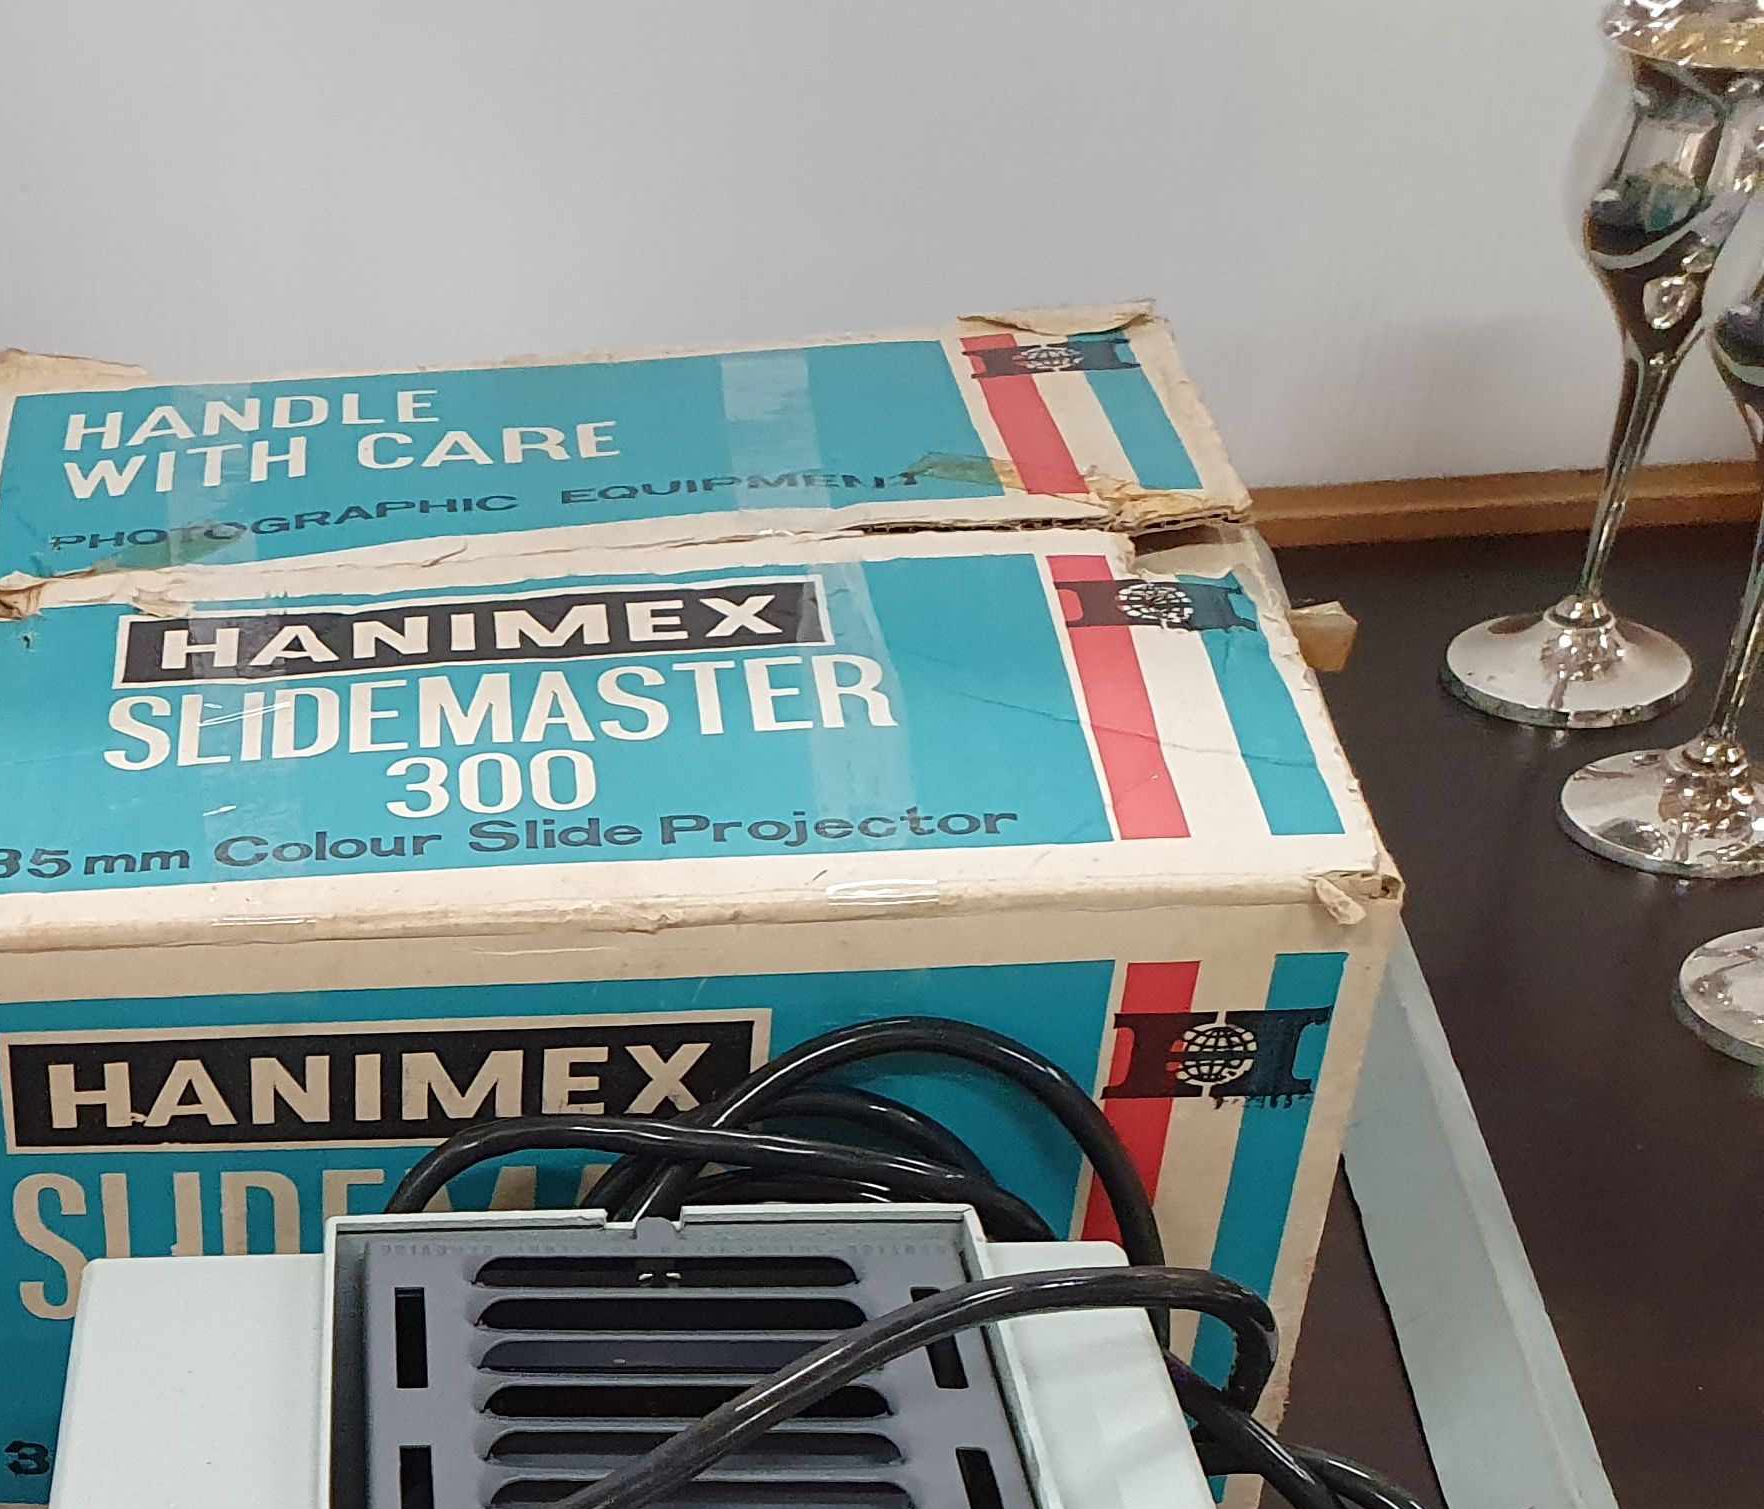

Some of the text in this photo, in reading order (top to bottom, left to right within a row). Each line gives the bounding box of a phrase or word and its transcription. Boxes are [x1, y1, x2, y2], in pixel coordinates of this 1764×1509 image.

[62, 389, 441, 452] HANDLE
[63, 420, 622, 499] WITH CARE
[50, 468, 924, 550] PHOTOGRAPHIC EQUIPMENT
[157, 593, 784, 672] HANIMEX
[102, 652, 900, 775] SLIDEMASTER
[385, 748, 598, 822] 300
[212, 830, 444, 868] Colour
[465, 816, 644, 855] Slide
[657, 803, 1020, 852] Projector
[48, 1042, 712, 1130] HANIMEX
